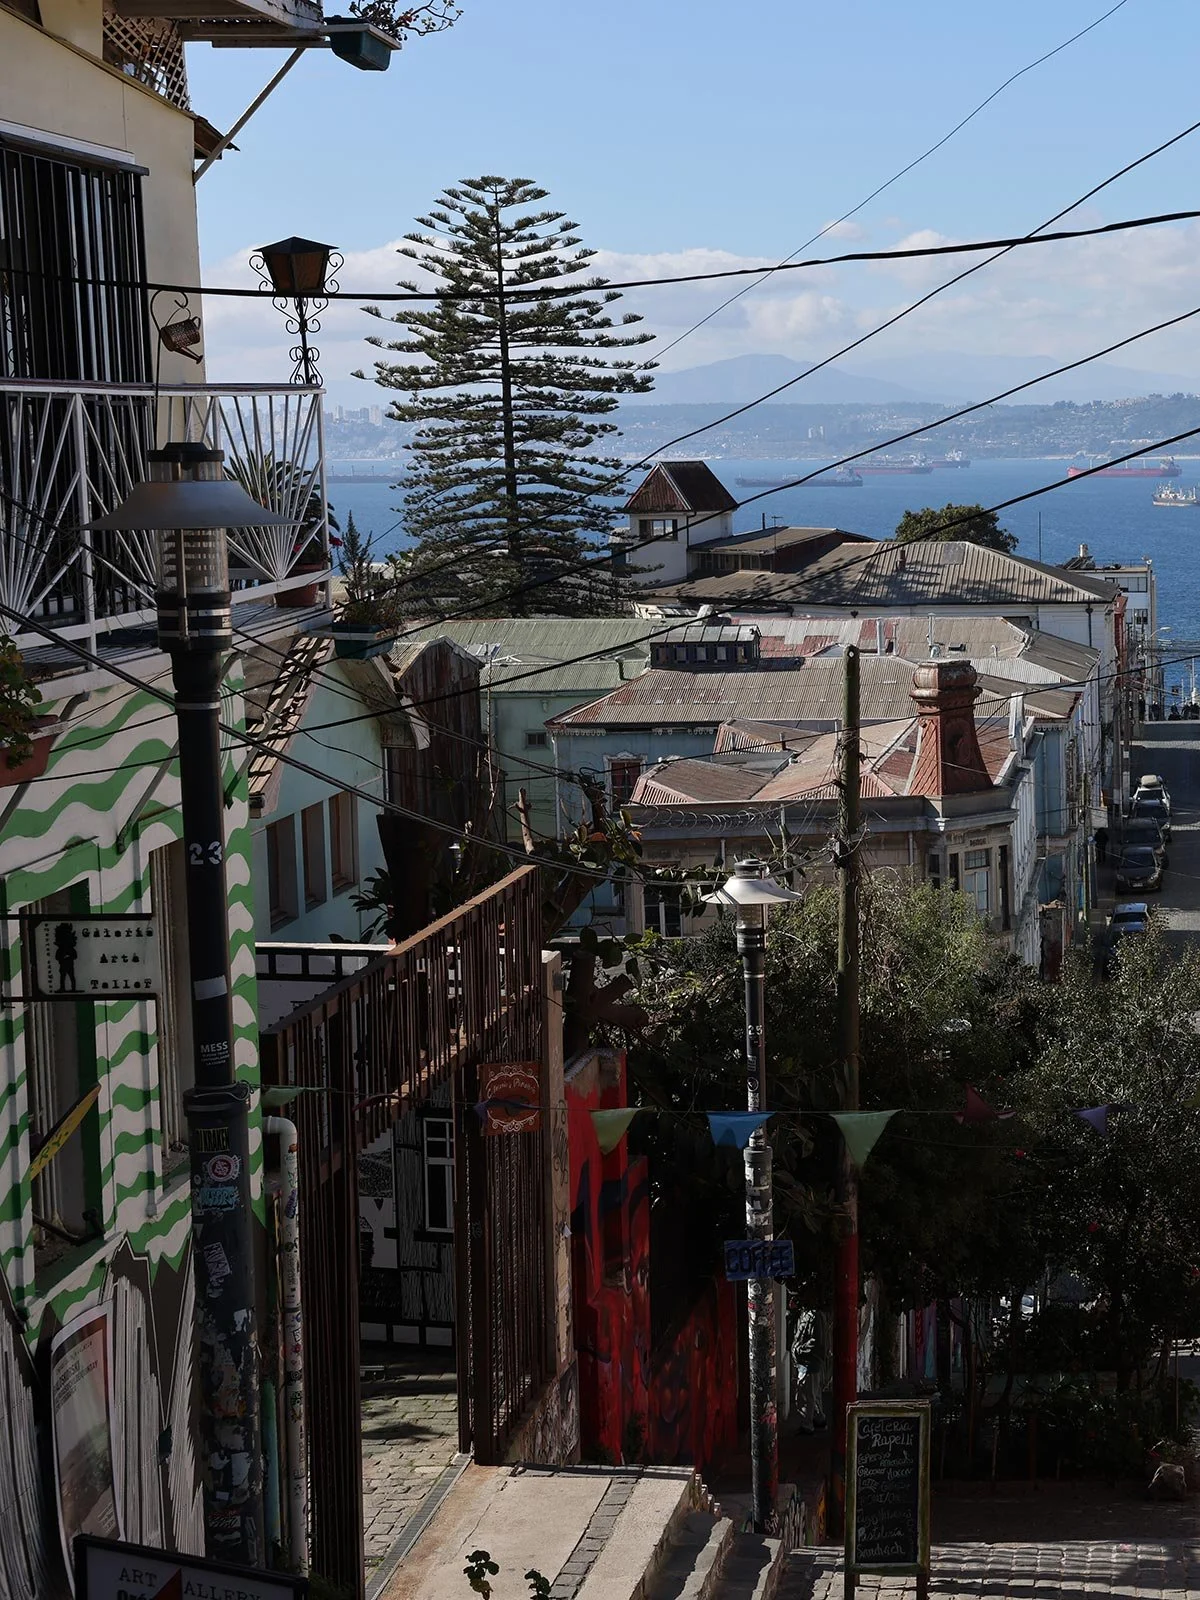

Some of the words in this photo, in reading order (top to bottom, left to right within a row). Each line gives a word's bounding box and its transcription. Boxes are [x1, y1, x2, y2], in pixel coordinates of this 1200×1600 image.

[189, 841, 222, 865] 23
[90, 978, 152, 990] Taller
[747, 1024, 763, 1036] 25
[200, 1041, 229, 1053] MESS
[119, 1568, 157, 1587] ART
